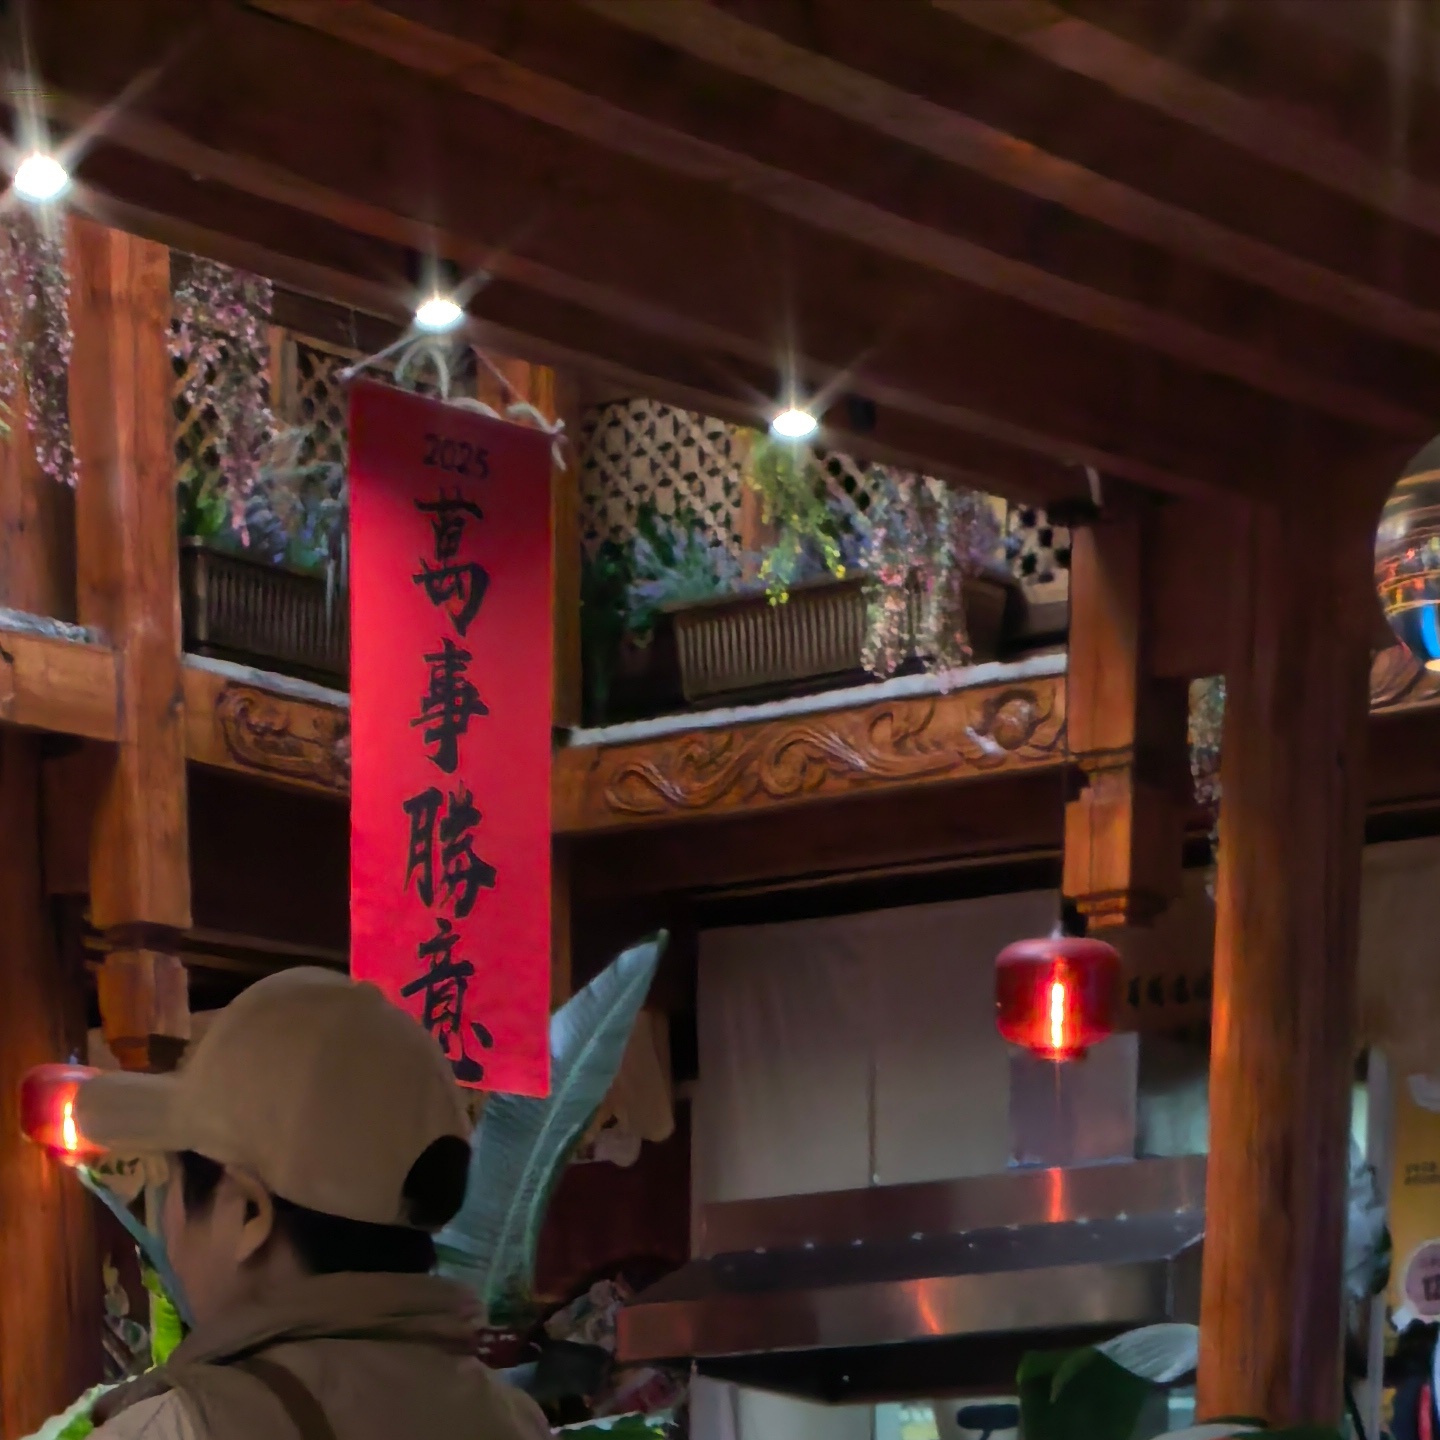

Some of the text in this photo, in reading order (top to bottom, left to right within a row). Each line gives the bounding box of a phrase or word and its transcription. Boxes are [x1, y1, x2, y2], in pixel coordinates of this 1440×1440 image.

[422, 432, 490, 480] 2025
[401, 486, 498, 1083] 萬事勝意
